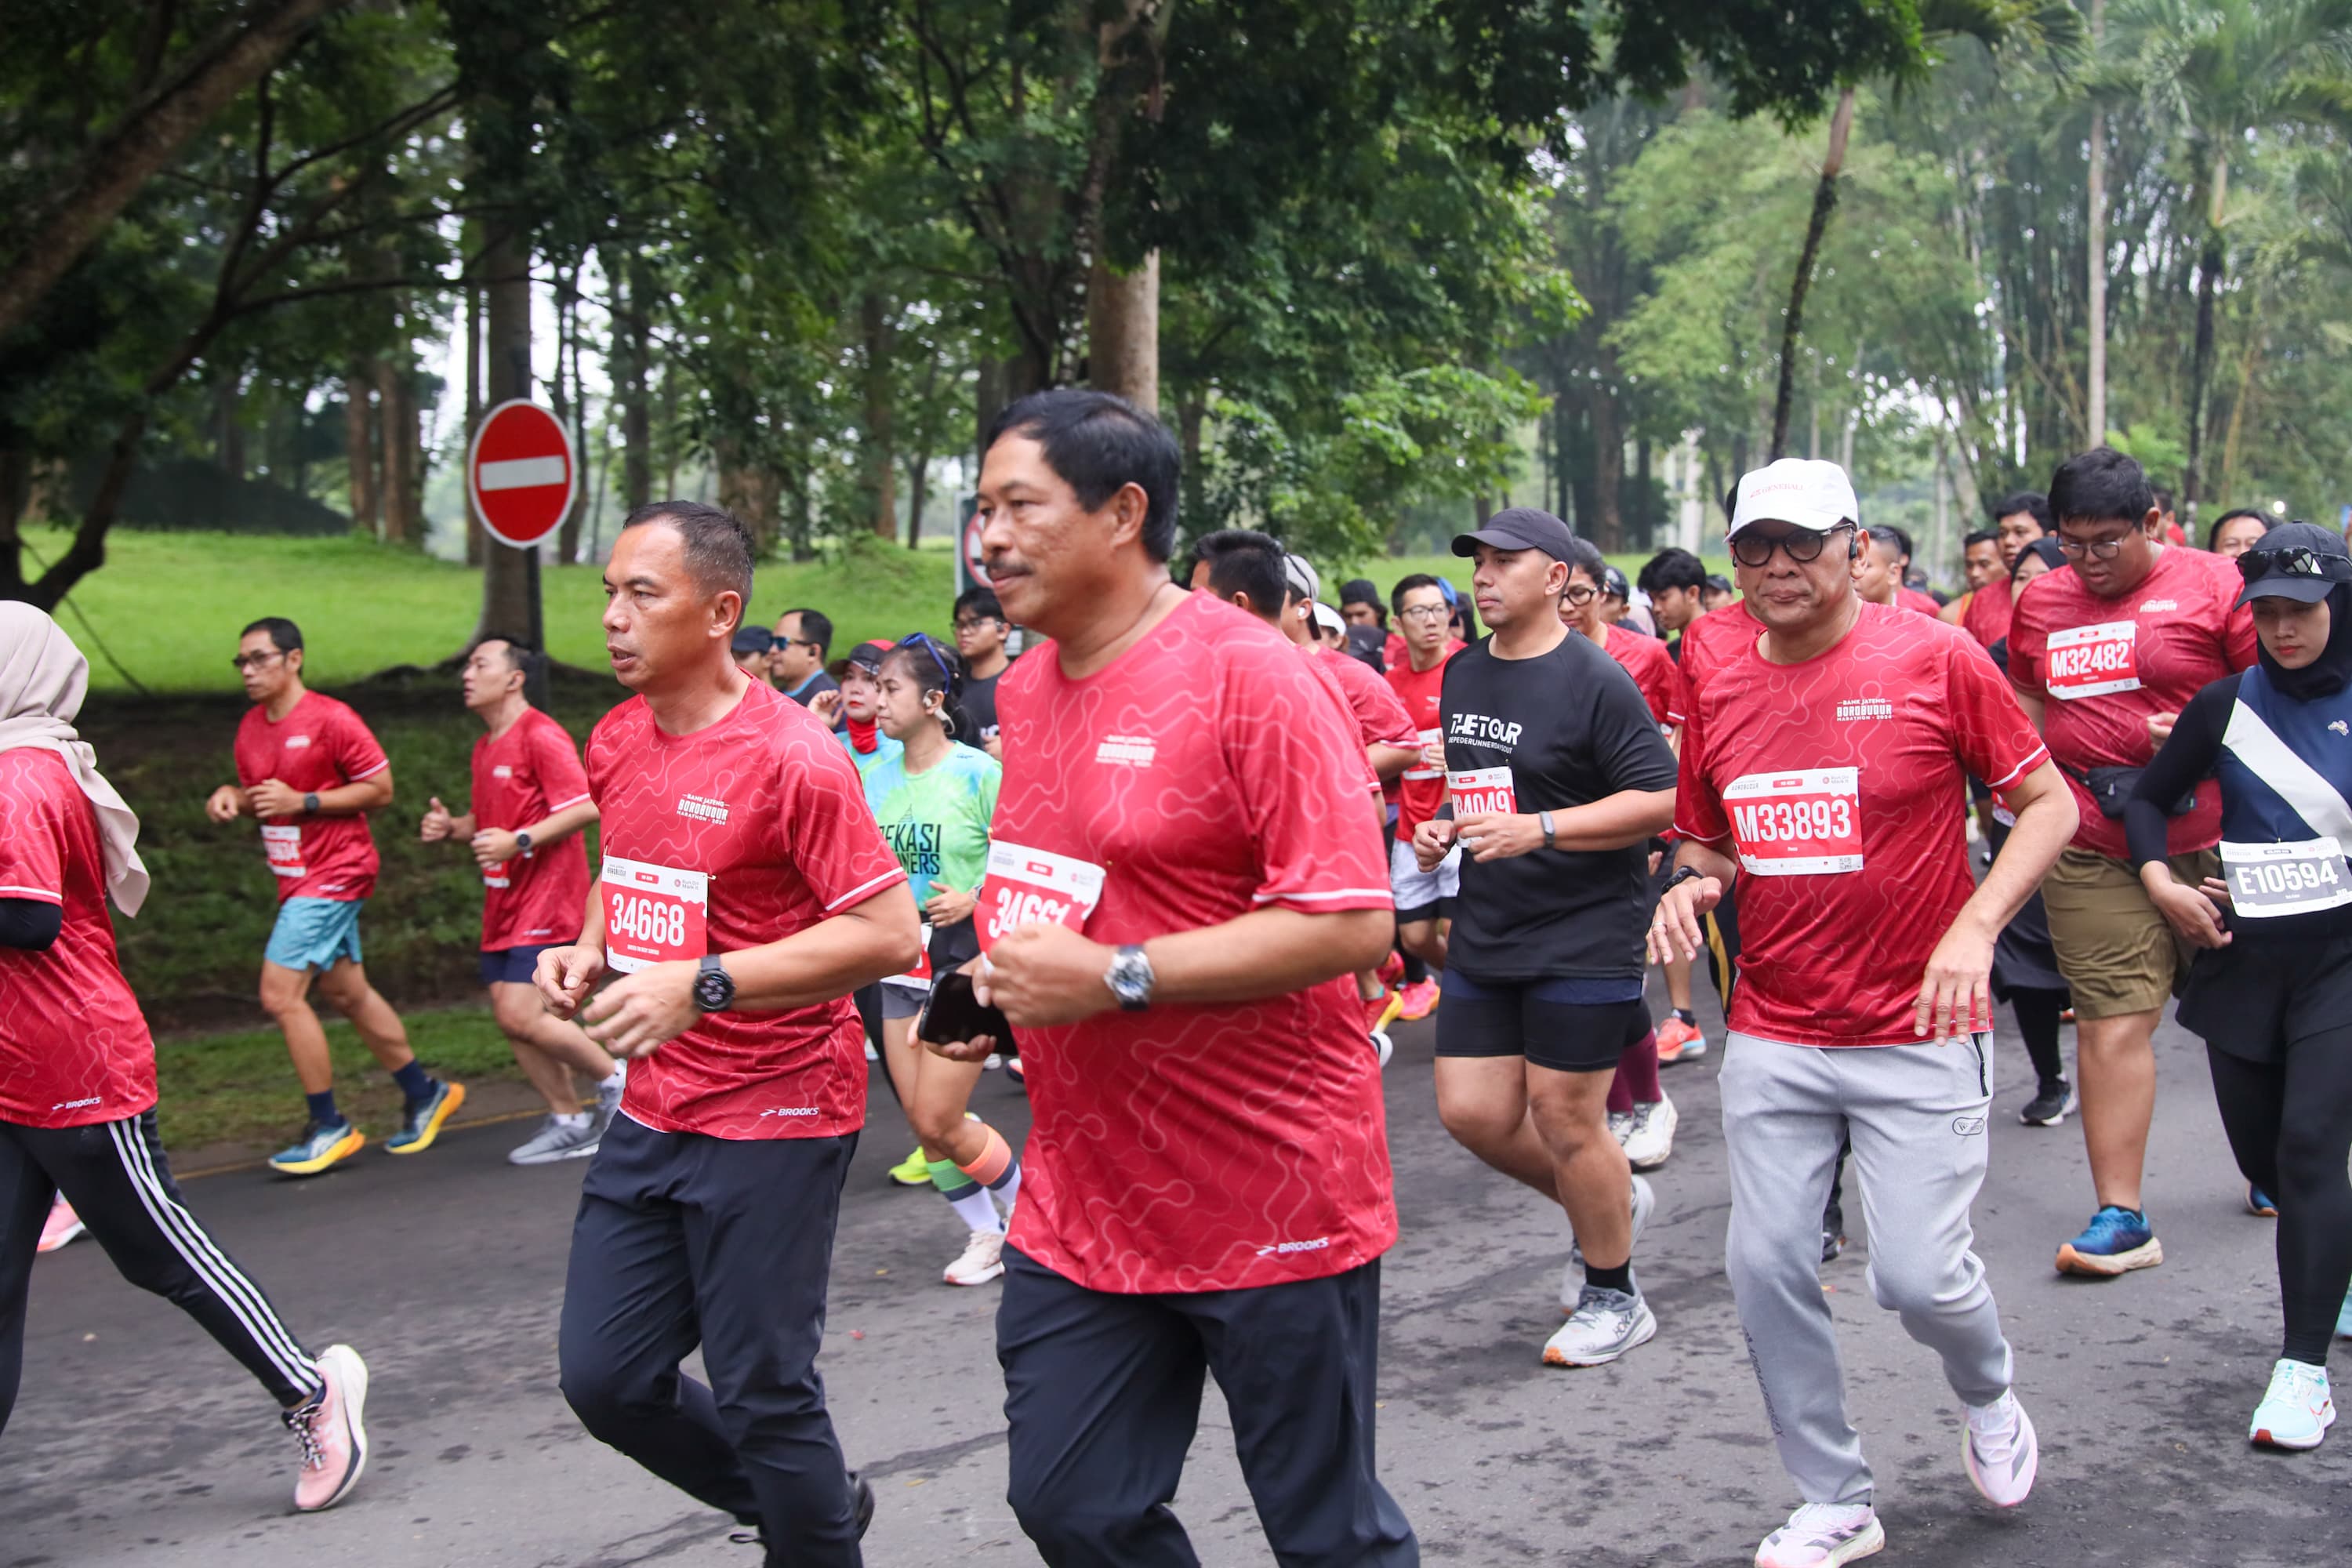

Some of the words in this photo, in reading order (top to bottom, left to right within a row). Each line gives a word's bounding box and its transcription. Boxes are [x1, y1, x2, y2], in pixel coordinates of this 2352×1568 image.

[2051, 641, 2130, 678] M32482
[1836, 704, 1892, 717] BOROBUDUR
[677, 798, 729, 821] BOROBUDUR
[687, 793, 704, 802] BANK
[702, 797, 725, 808] JATENG
[677, 810, 708, 822] MARATHON
[1733, 799, 1852, 843] M33893
[879, 822, 942, 853] EKASI
[2235, 860, 2339, 895] E10594
[610, 892, 685, 947] 34668
[65, 1096, 101, 1109] BROOKS
[777, 1107, 820, 1116] BROOKS
[1277, 1236, 1330, 1254] BROOKS
